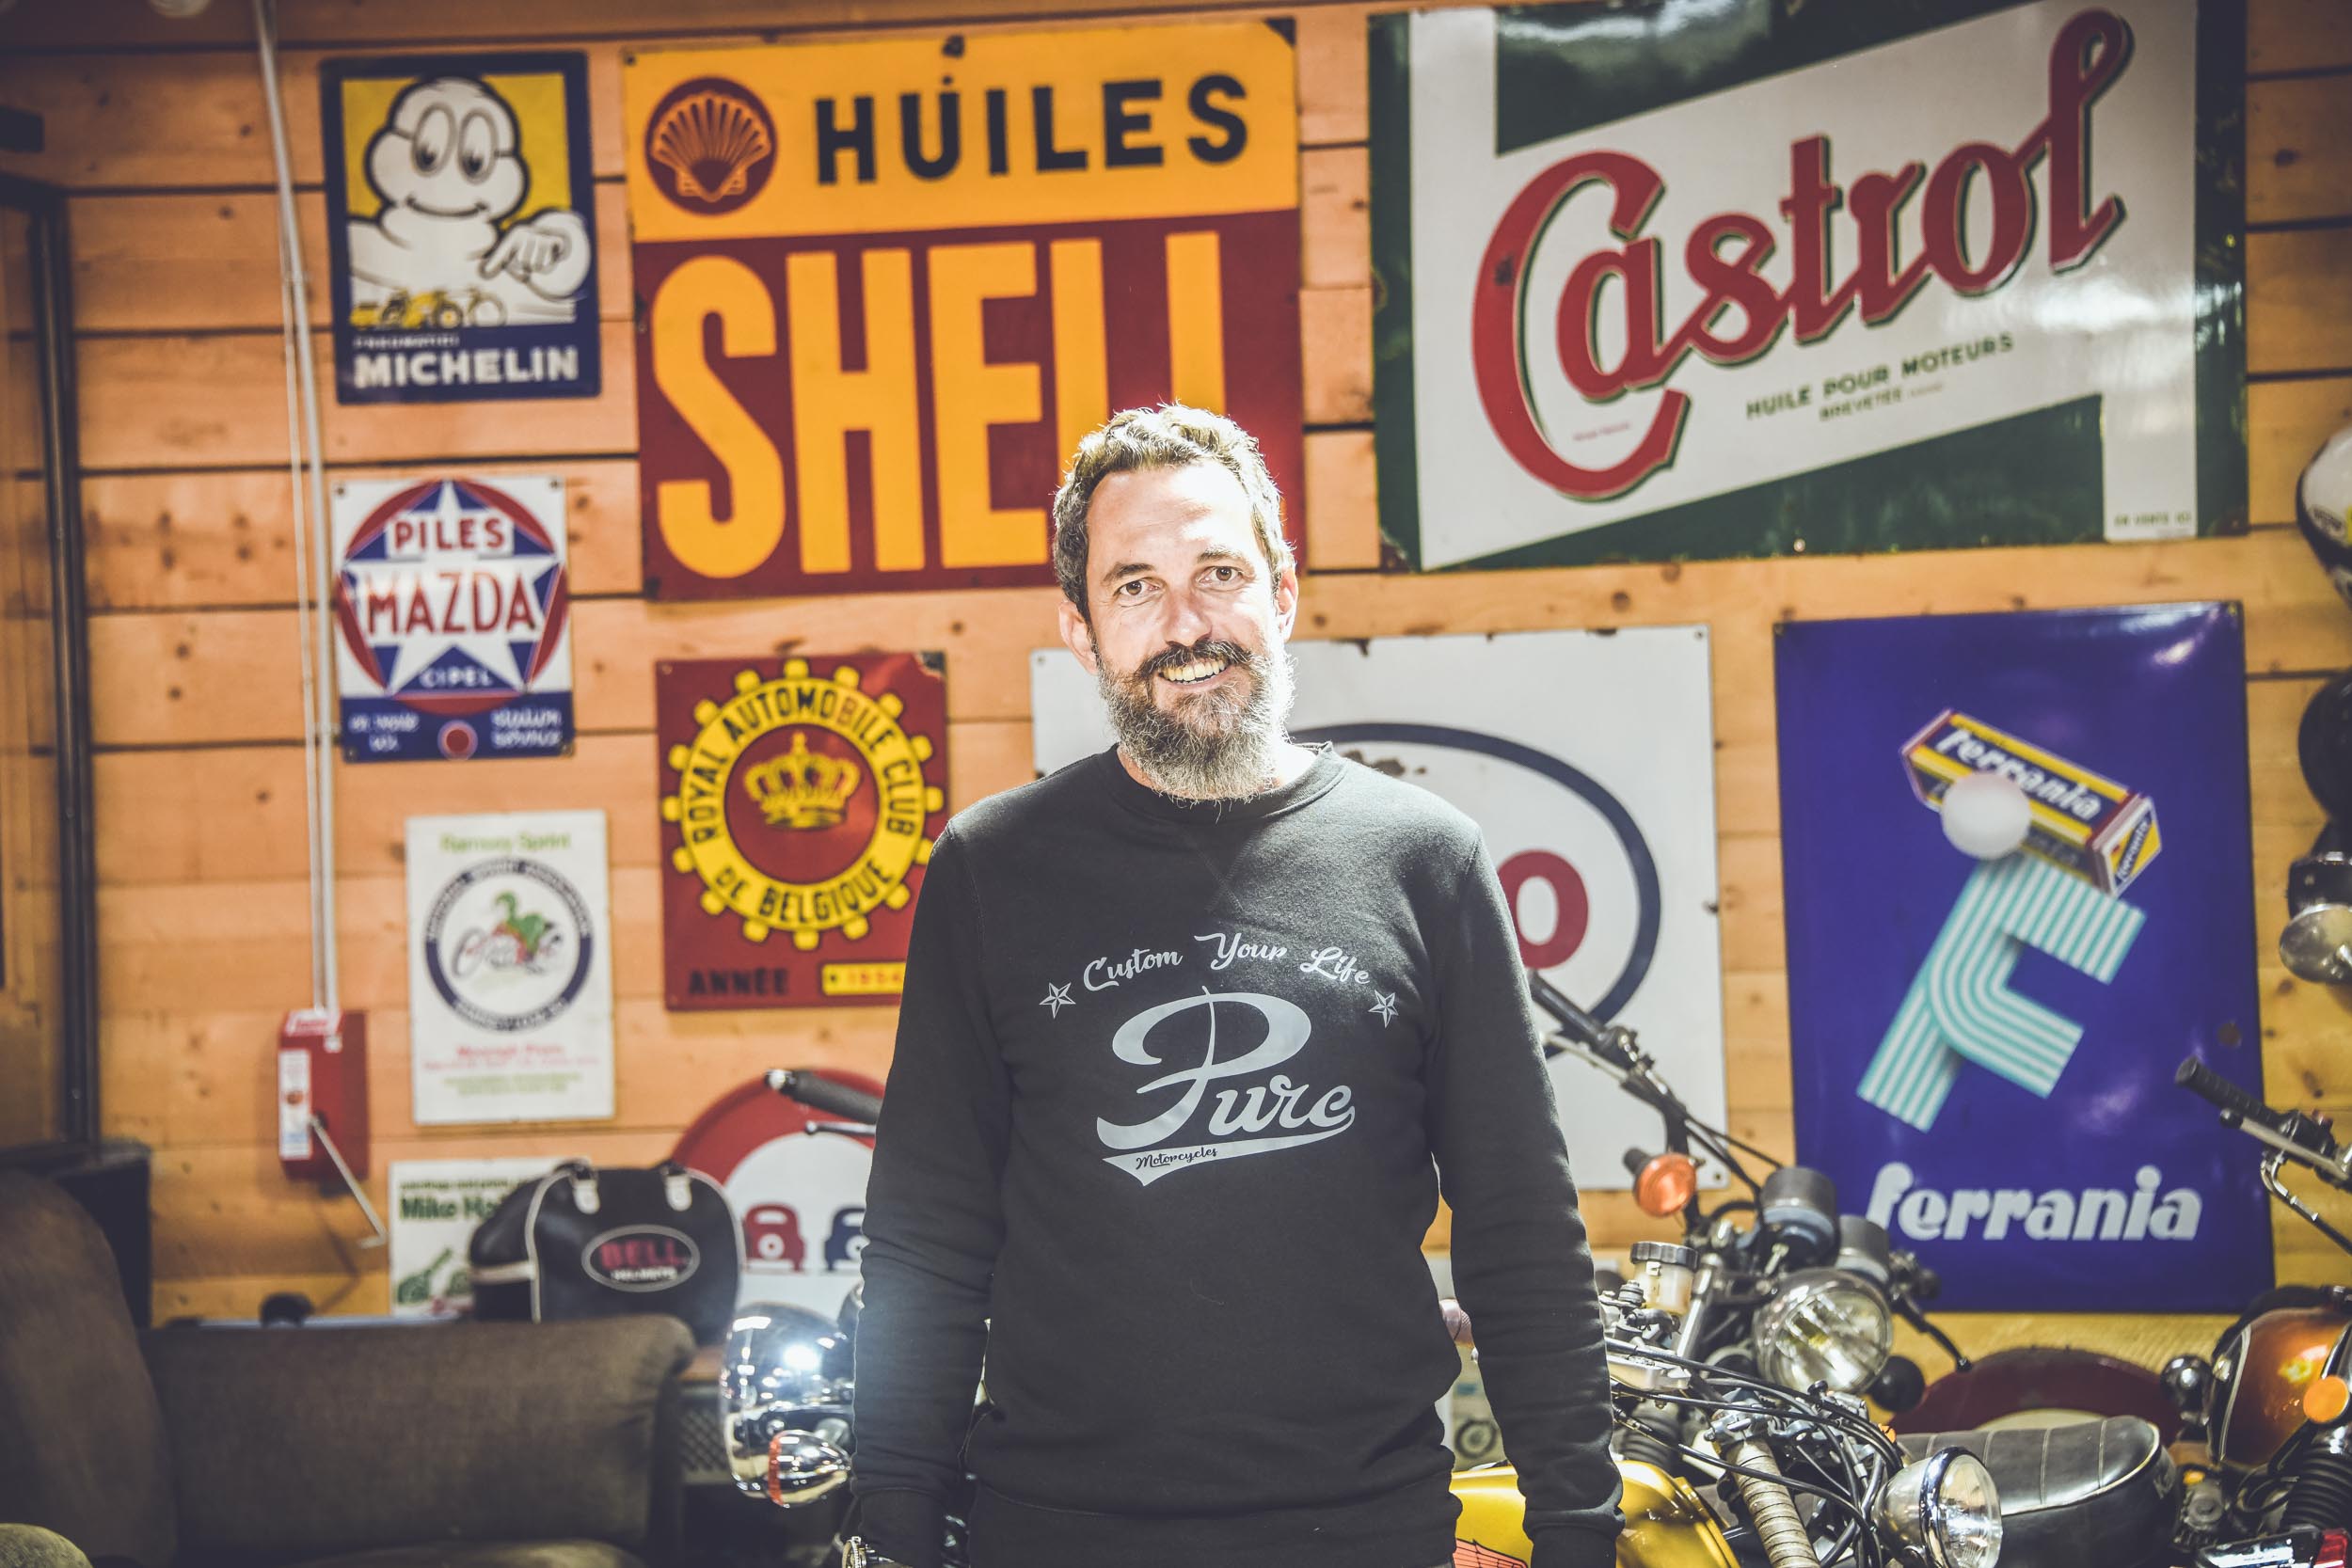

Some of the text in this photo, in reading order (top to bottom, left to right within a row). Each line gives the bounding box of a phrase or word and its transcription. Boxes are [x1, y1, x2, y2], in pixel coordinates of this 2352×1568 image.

[815, 74, 1248, 184] HUILES
[1472, 8, 2135, 501] Castrol
[353, 346, 580, 389] MICHELIN
[1745, 383, 1812, 420] HUILE
[1822, 363, 1891, 398] POUR
[1900, 331, 2013, 377] MOTEURS
[393, 516, 506, 550] PILES
[365, 570, 536, 635] MAZDA
[688, 687, 919, 845] ROYAL AUTOMOBILE CLUB
[757, 859, 894, 925] BELGIQUE
[1083, 932, 1371, 991] Custom Your Life
[1096, 985, 1356, 1150] Pure
[1136, 1147, 1218, 1171] Motorcycles
[1867, 1162, 2202, 1242] ferrania
[599, 1237, 691, 1270] BELL
